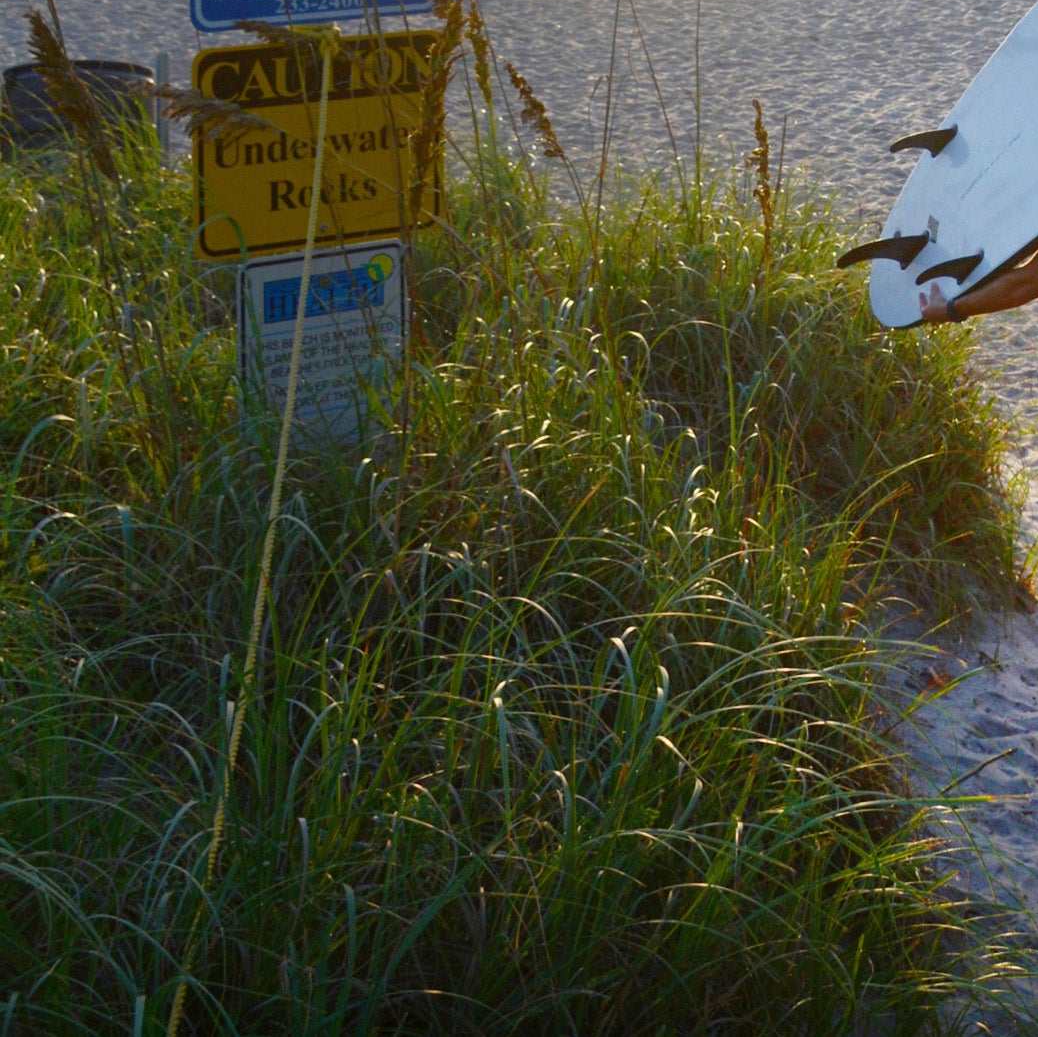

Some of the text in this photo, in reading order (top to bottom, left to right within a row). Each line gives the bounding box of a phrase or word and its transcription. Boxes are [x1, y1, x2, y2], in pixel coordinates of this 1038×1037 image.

[214, 124, 417, 169] Underwate
[267, 173, 378, 212] Rocks
[269, 283, 380, 319] HALTH
[258, 321, 394, 352] HIS BECH IS MONITED
[303, 346, 317, 360] OF
[271, 360, 320, 378] BEAHES
